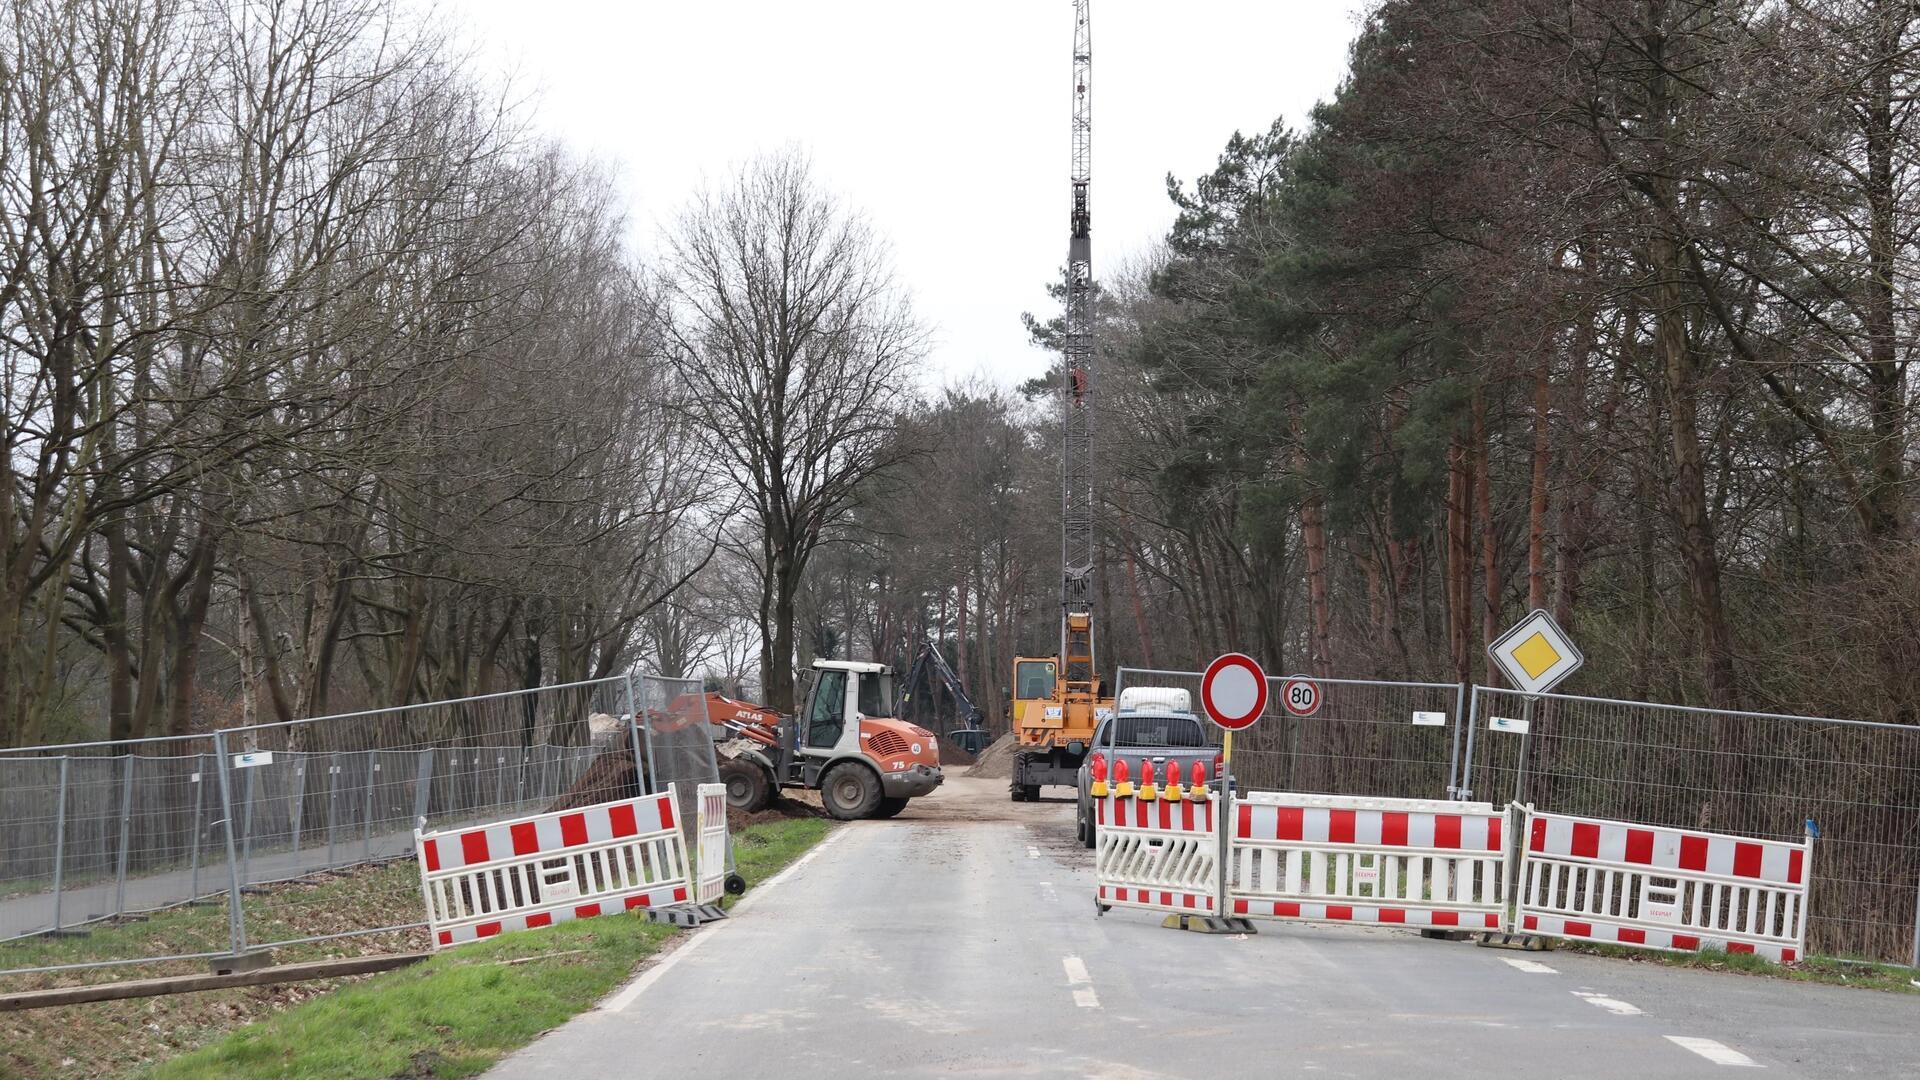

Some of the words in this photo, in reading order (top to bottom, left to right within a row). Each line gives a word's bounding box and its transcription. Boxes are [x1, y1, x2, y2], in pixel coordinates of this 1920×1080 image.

[1292, 687, 1312, 705] 80
[735, 710, 763, 721] ATLAS
[892, 761, 905, 770] 75
